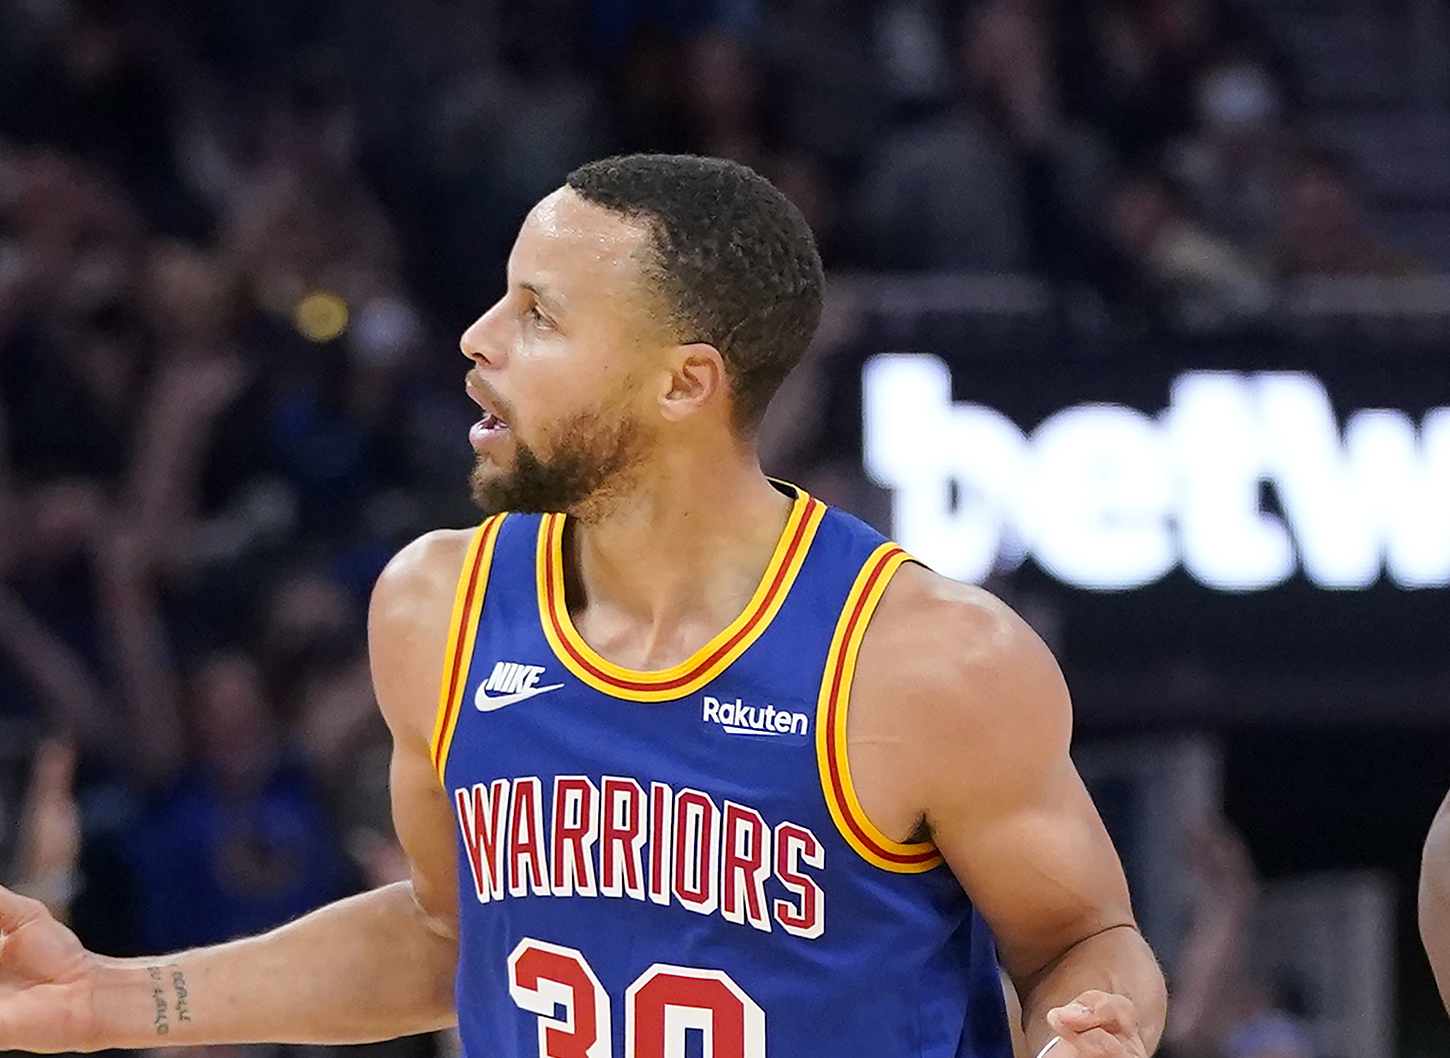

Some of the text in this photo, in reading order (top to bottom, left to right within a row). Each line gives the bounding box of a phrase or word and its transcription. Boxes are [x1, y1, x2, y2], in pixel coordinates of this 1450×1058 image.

[485, 661, 547, 695] NIKE
[702, 696, 809, 736] Rakuten
[455, 775, 825, 940] WARRIORS
